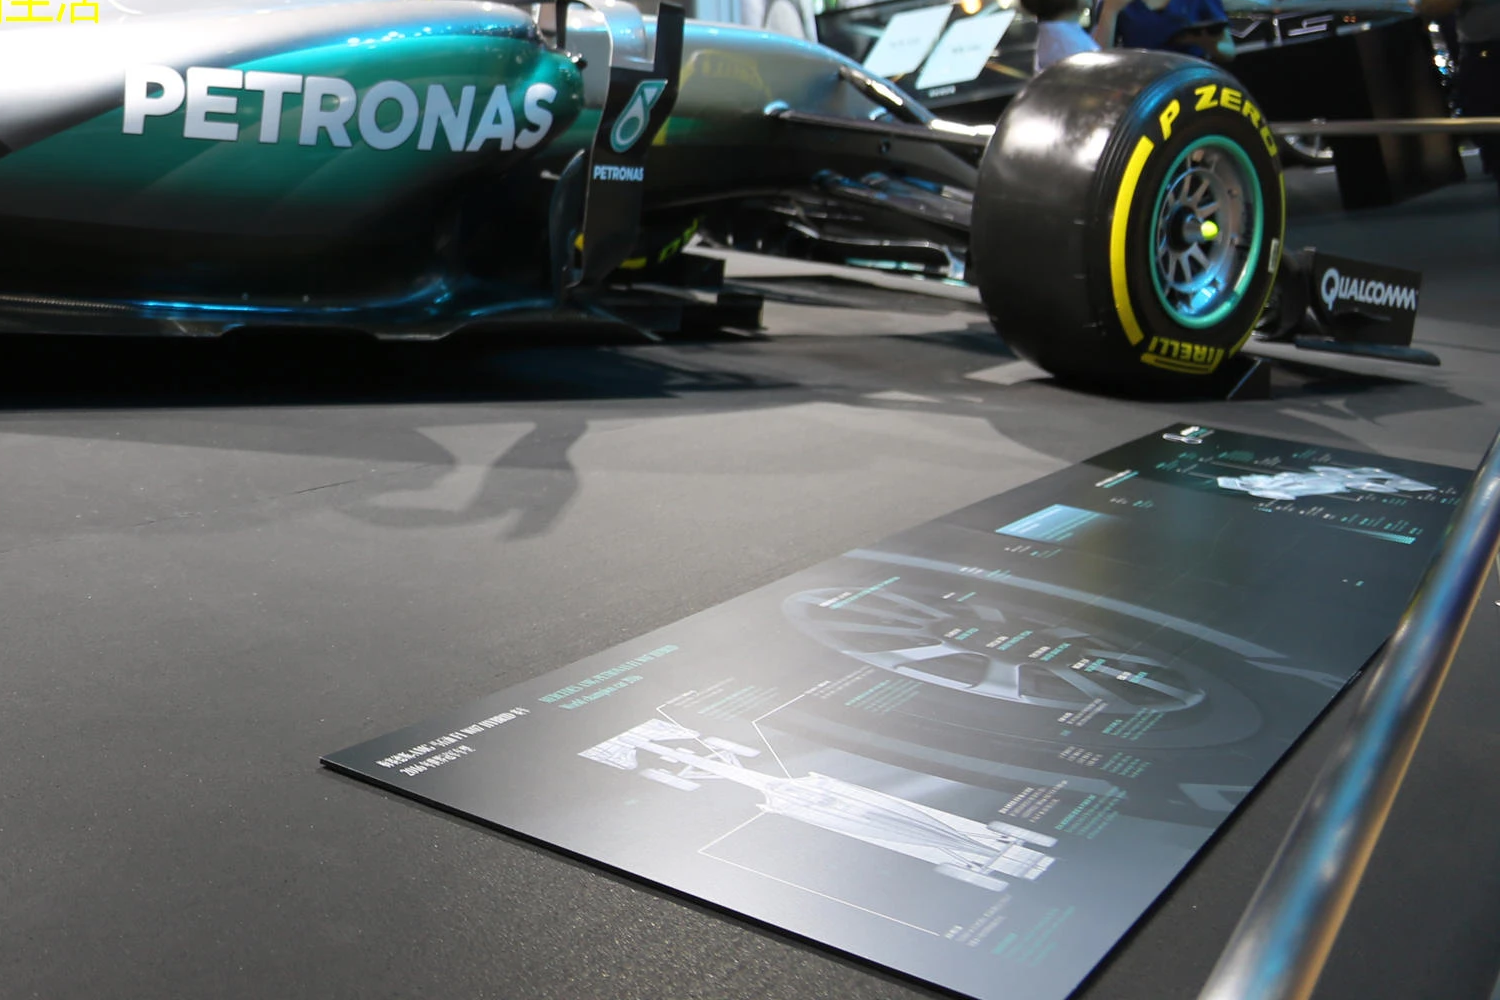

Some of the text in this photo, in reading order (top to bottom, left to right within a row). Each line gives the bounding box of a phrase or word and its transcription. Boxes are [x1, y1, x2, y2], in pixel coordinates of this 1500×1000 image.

[121, 64, 559, 153] PETRONAS
[1159, 83, 1278, 157] P ZERO
[1321, 267, 1417, 311] QUALCOMM
[1141, 336, 1225, 375] PIRELLI
